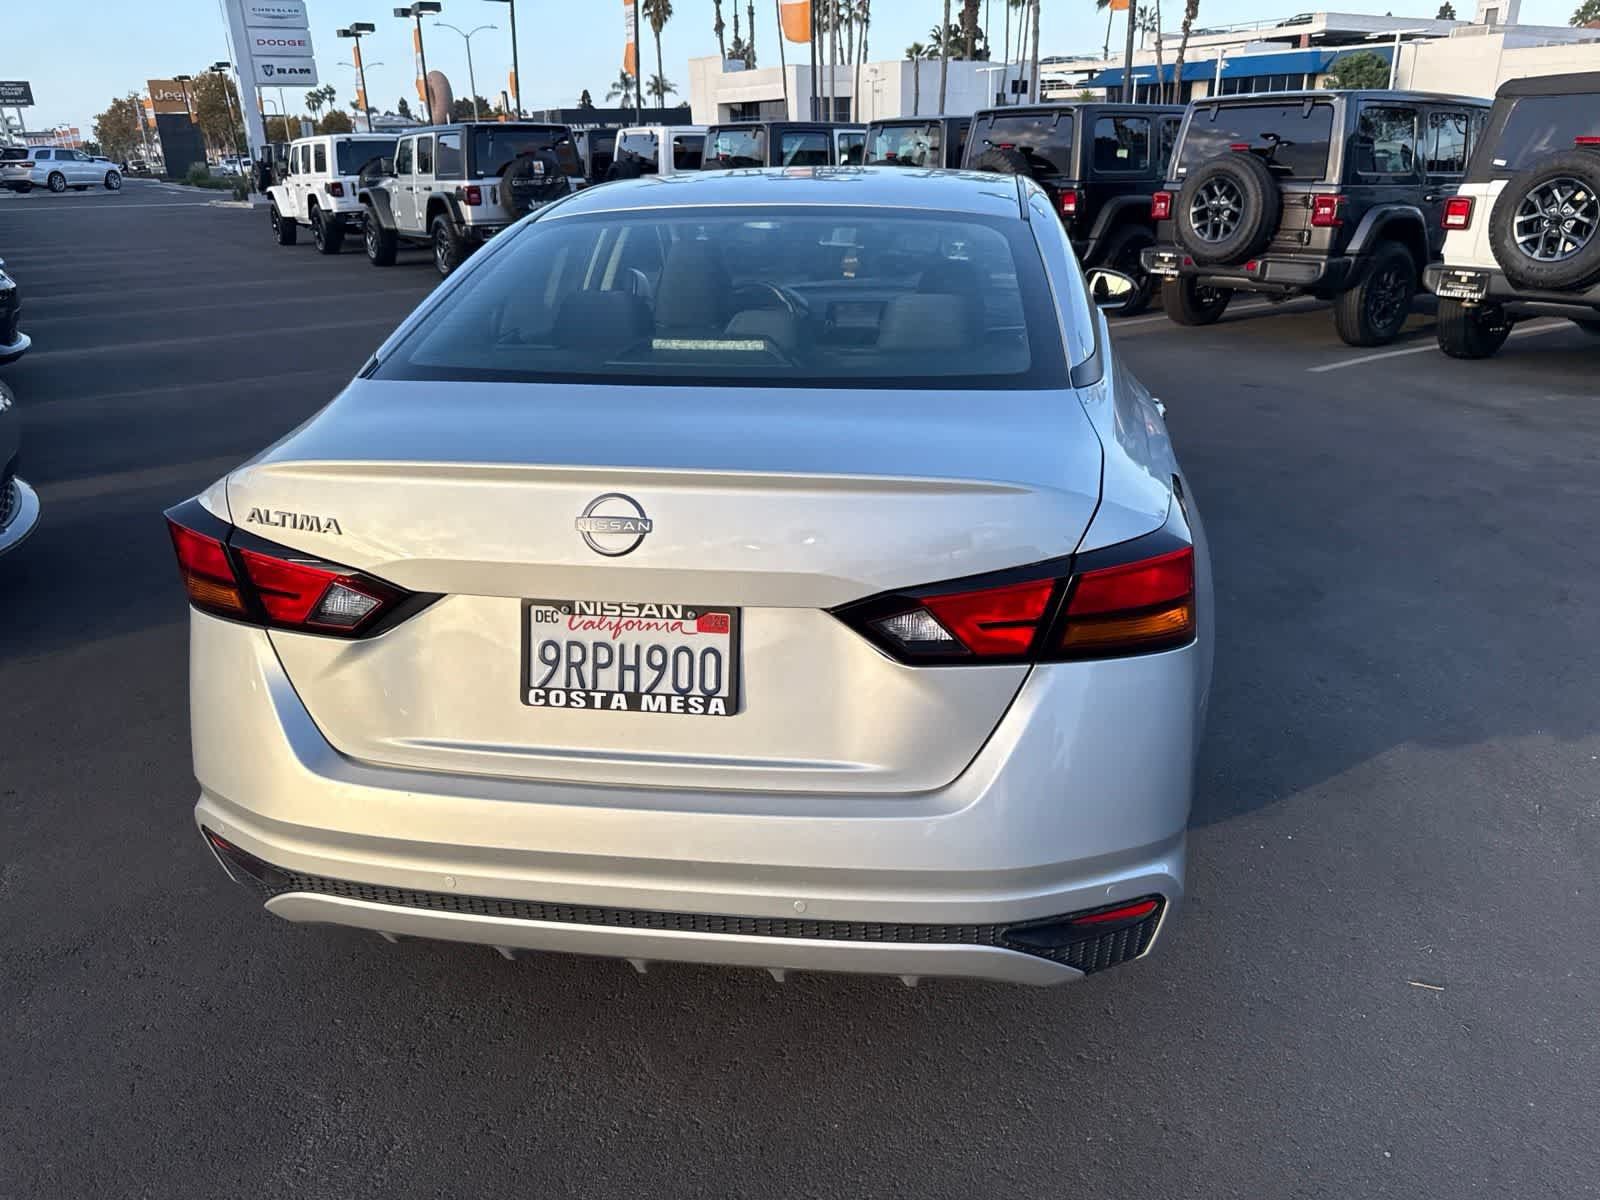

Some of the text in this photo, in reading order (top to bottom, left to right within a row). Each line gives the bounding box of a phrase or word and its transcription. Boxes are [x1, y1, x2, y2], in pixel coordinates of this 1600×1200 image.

[256, 39, 306, 47] DODGE
[277, 67, 311, 75] RAM
[247, 507, 343, 535] ALTIMA
[577, 519, 650, 532] NISSAN
[535, 609, 560, 624] DEC
[574, 600, 683, 619] NISSAN
[567, 614, 699, 640] California
[535, 639, 722, 696] 9RPH900
[528, 688, 727, 716] COSTA MESA
